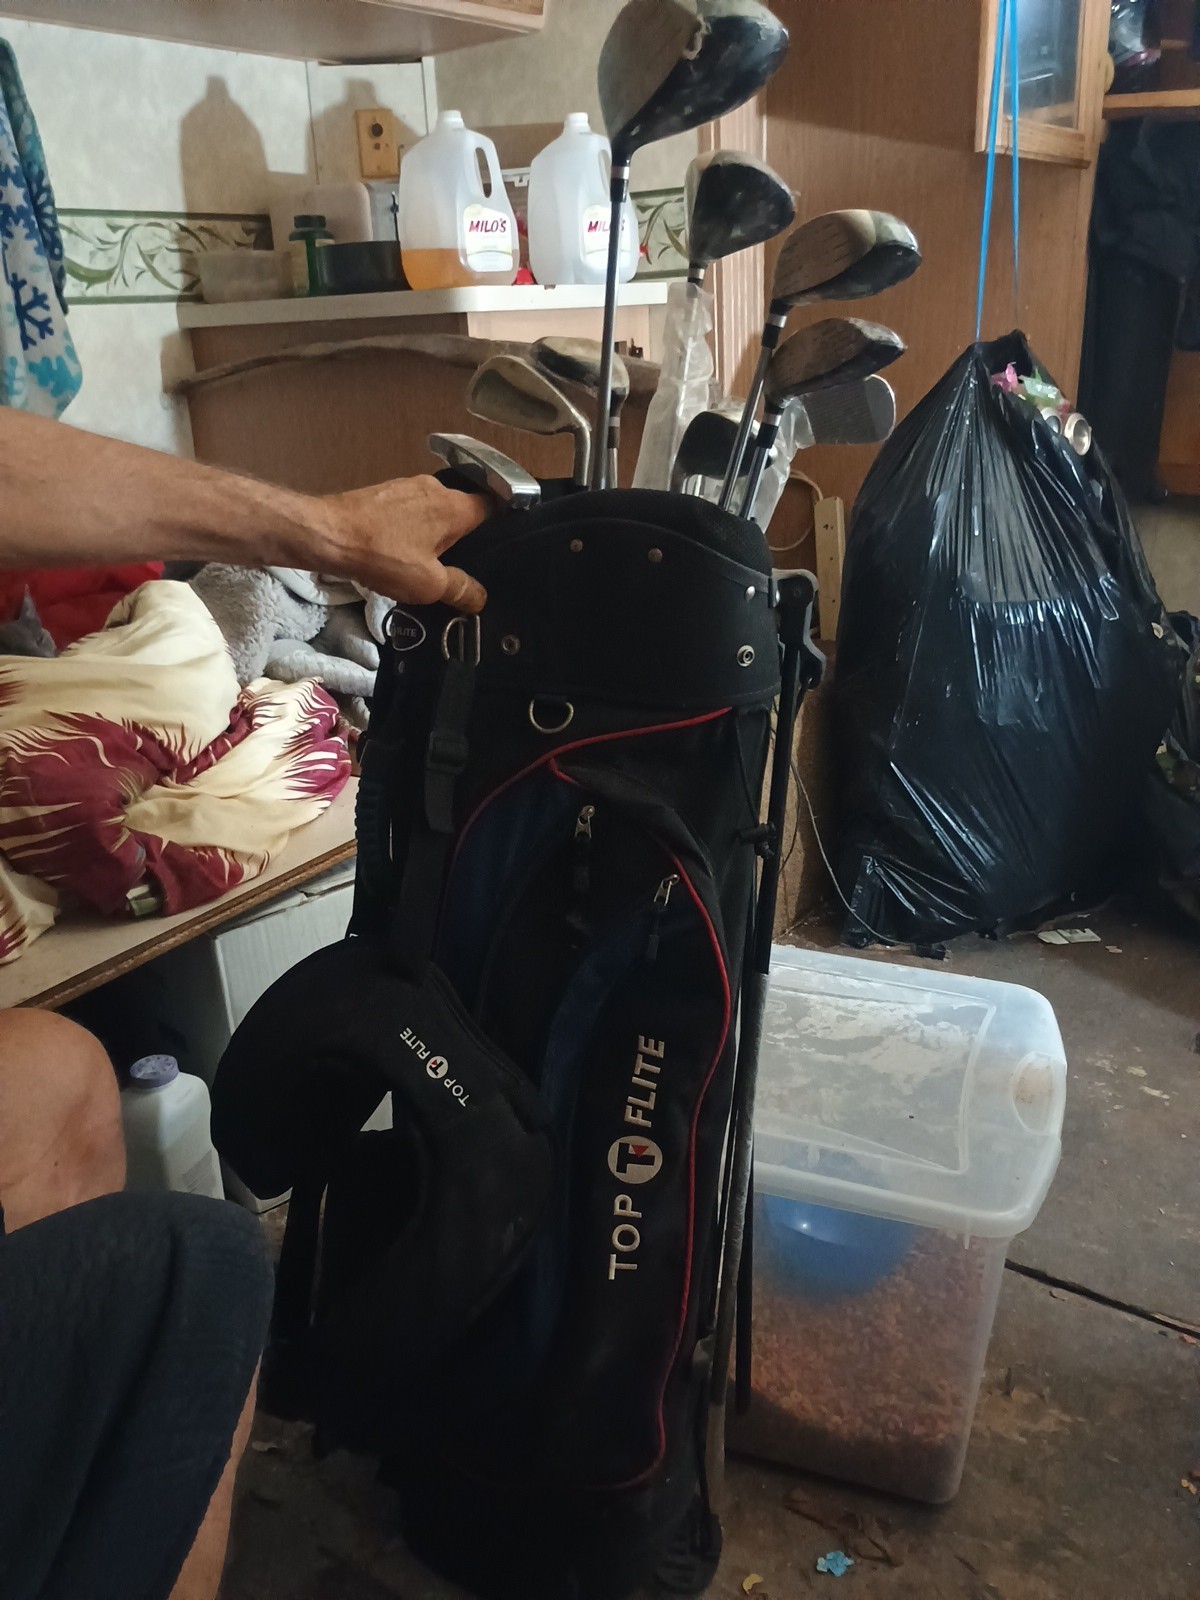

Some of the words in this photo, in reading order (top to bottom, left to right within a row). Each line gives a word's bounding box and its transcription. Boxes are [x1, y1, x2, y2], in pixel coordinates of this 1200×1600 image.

[469, 218, 507, 233] MILO'S
[588, 220, 625, 232] MILS
[400, 1027, 431, 1060] FLITE
[443, 1078, 470, 1107] TOP
[623, 1034, 666, 1129] FLITE
[607, 1193, 643, 1281] TOP
